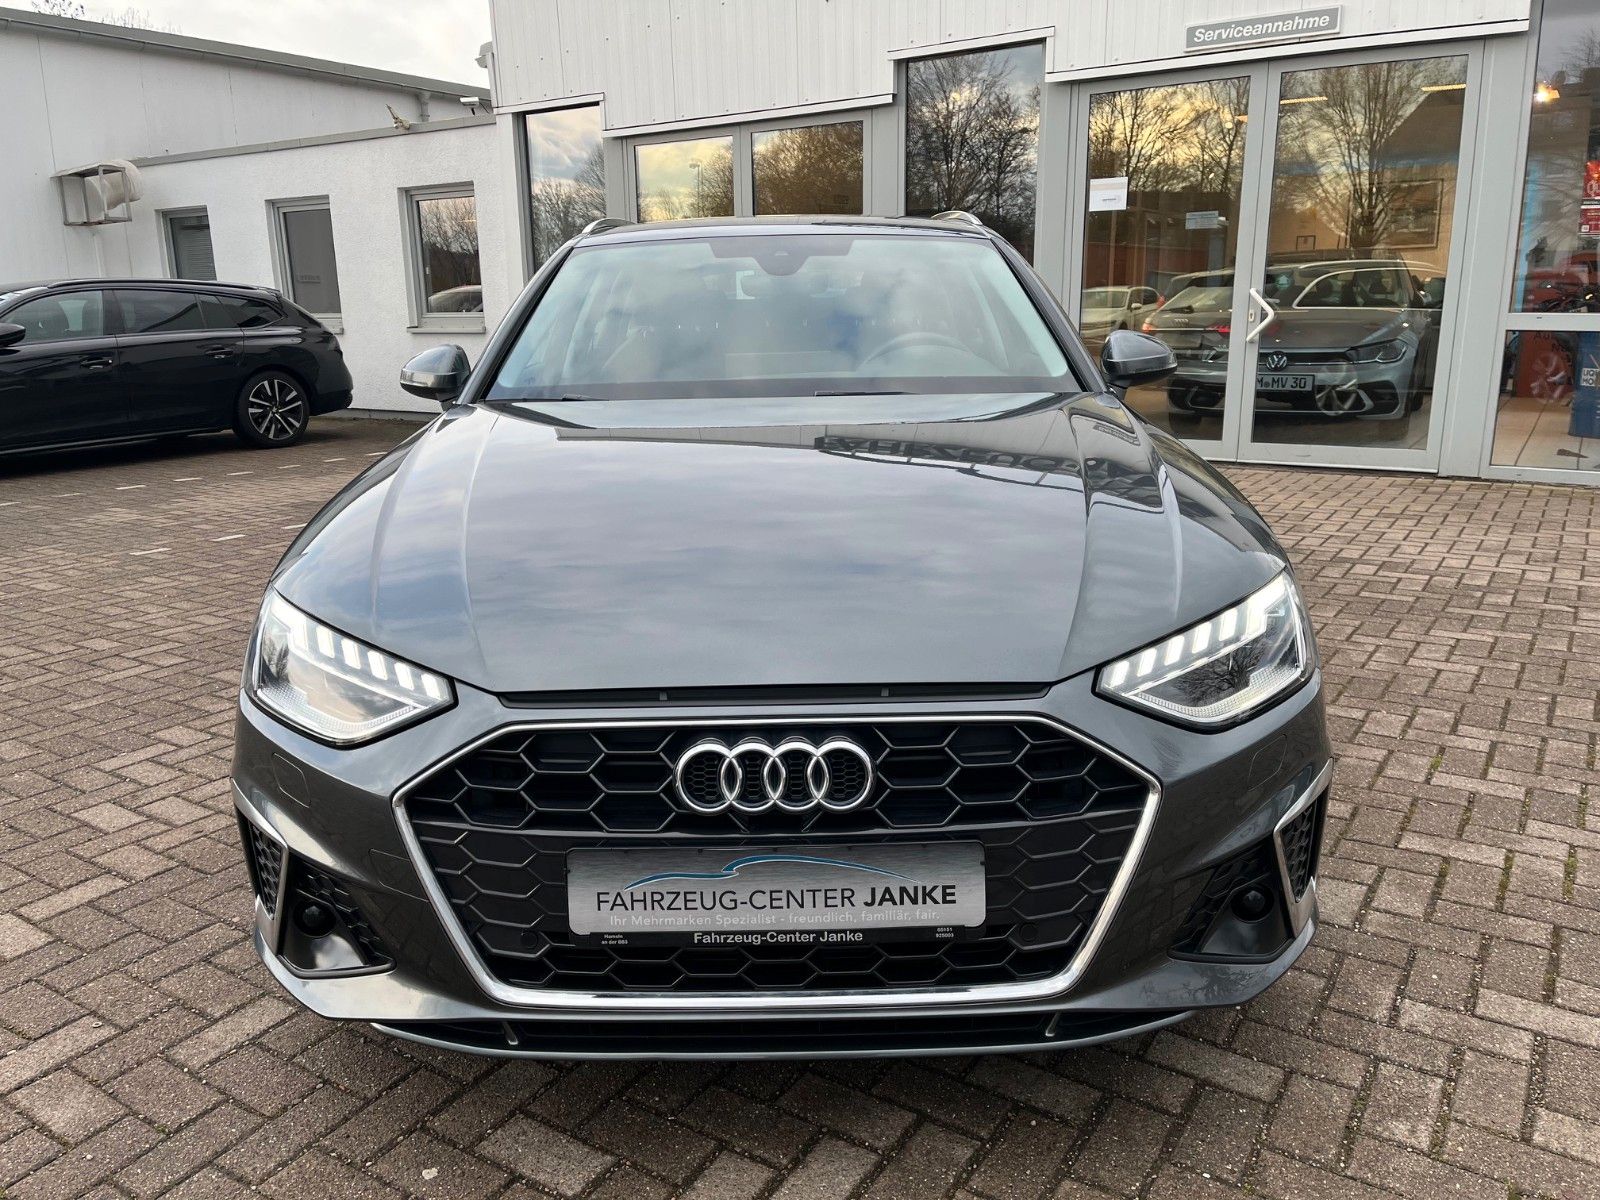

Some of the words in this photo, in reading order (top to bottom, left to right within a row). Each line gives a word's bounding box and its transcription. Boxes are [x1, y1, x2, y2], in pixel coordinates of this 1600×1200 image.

[1193, 14, 1330, 43] Serviceannahme
[1271, 376, 1289, 388] MV
[1290, 377, 1307, 389] 30
[596, 887, 856, 912] FAHRZEUG-CENTER
[863, 884, 957, 907] JANKE
[609, 915, 627, 926] Ihr
[631, 914, 712, 926] Mehrmarken
[715, 913, 777, 927] Spezialist
[788, 910, 858, 924] freundlich,
[861, 909, 912, 922] familiär,
[916, 908, 940, 921] fair.
[693, 931, 816, 945] Fahrzeug-Center
[819, 931, 863, 943] Janke
